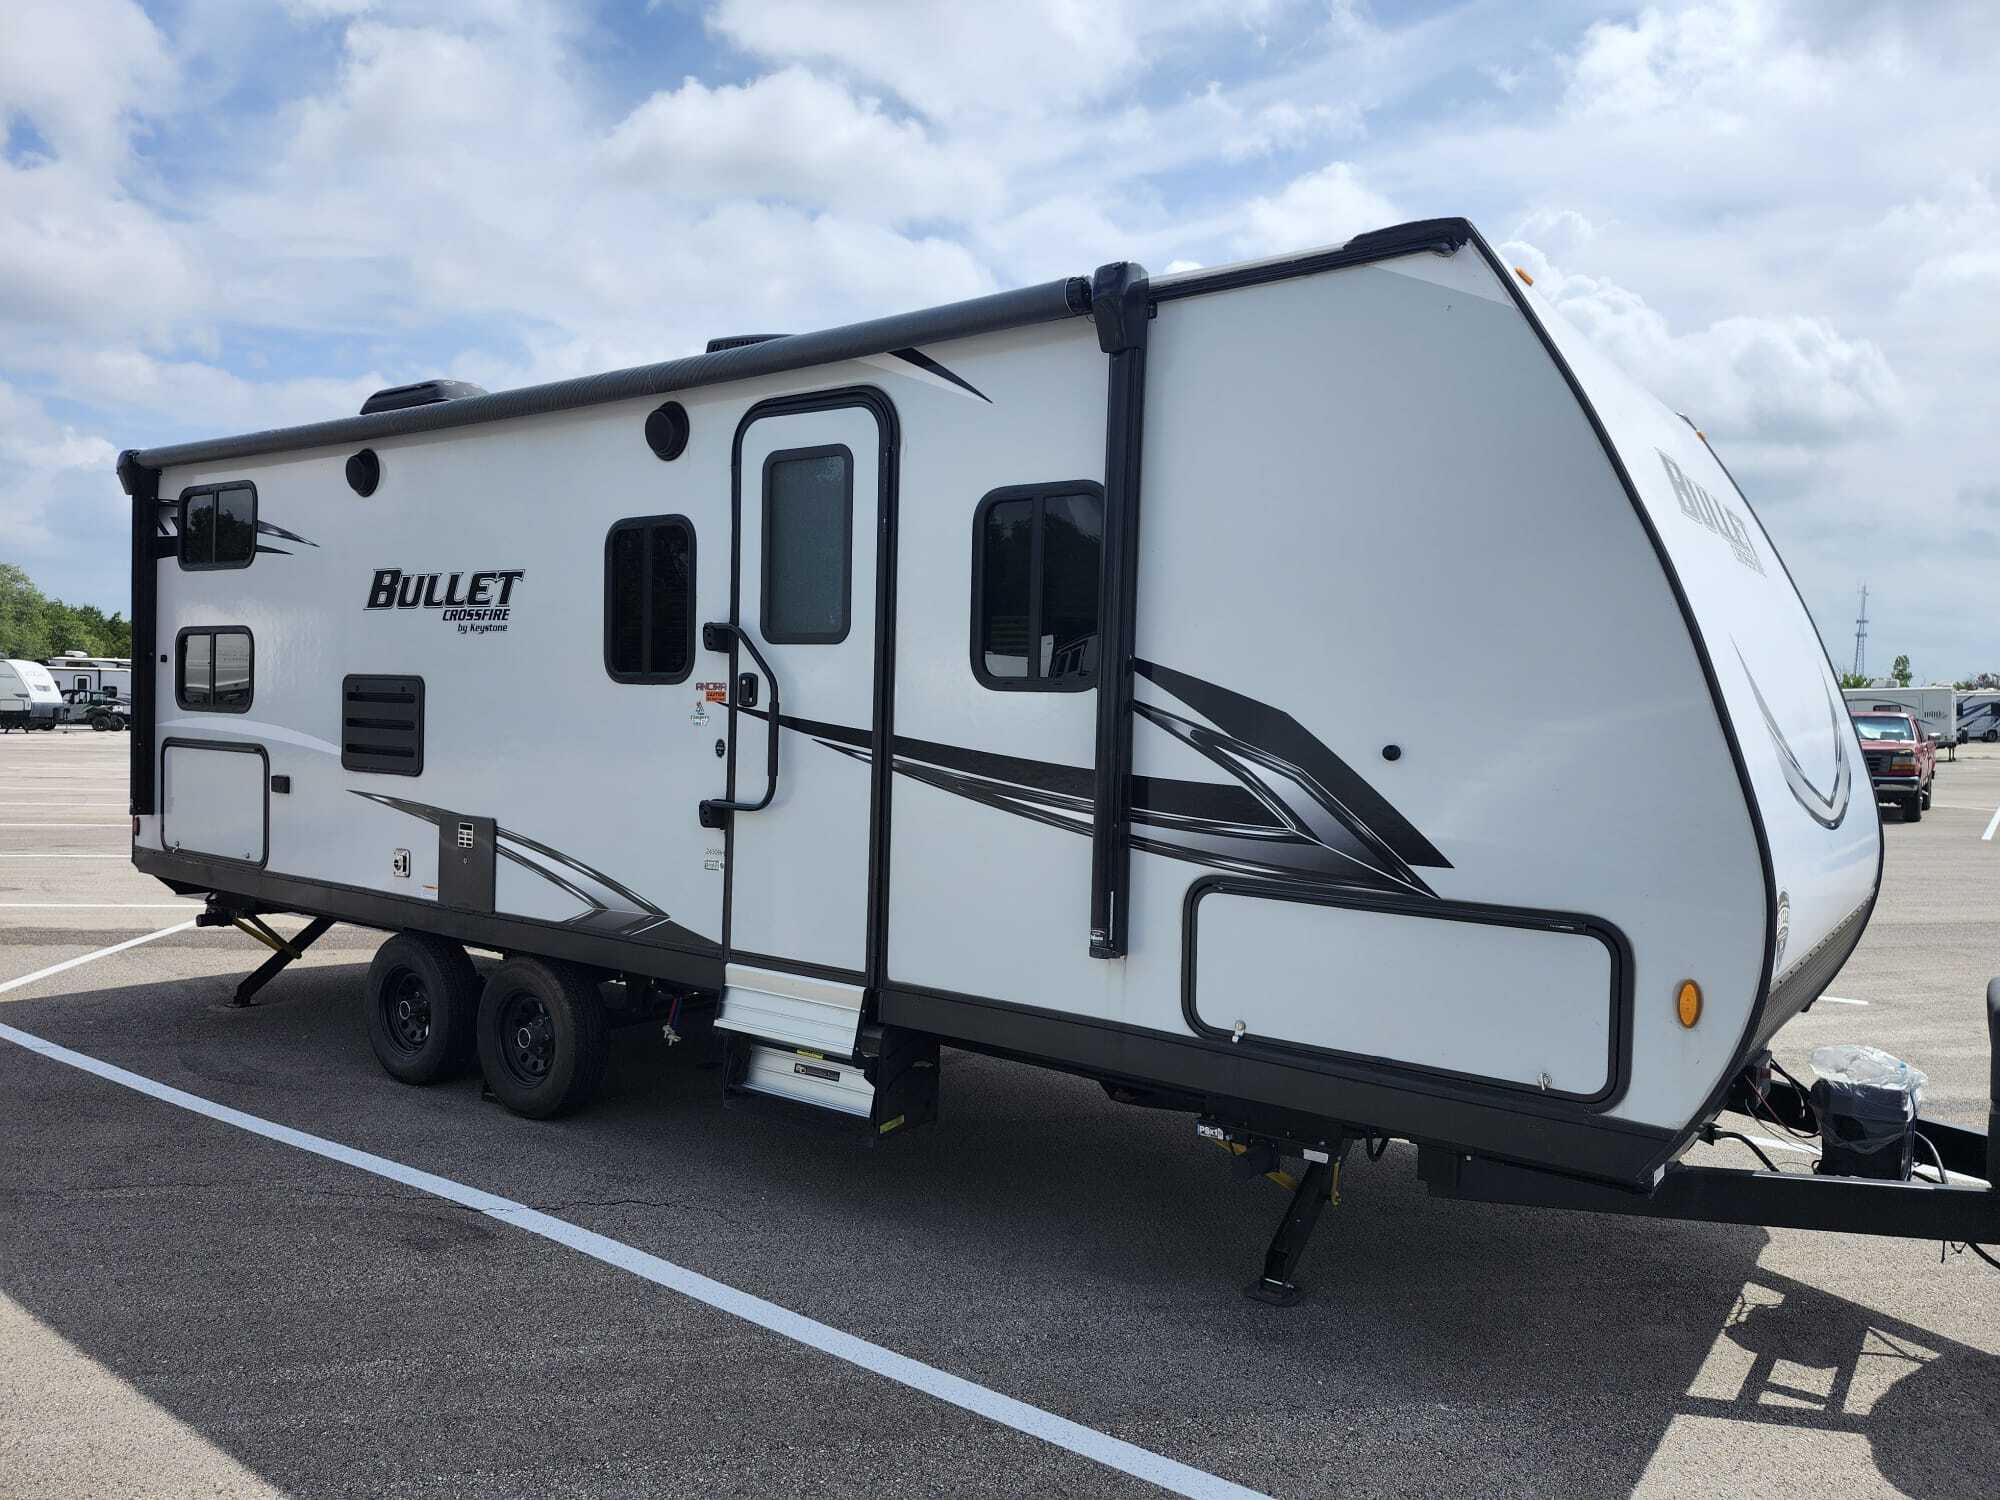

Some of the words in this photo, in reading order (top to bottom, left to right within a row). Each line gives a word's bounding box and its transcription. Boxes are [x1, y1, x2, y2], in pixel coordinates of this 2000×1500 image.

[363, 568, 525, 610] BULLET
[442, 609, 511, 621] CROSSFIRE
[458, 624, 467, 634] by
[470, 624, 508, 634] Keystone
